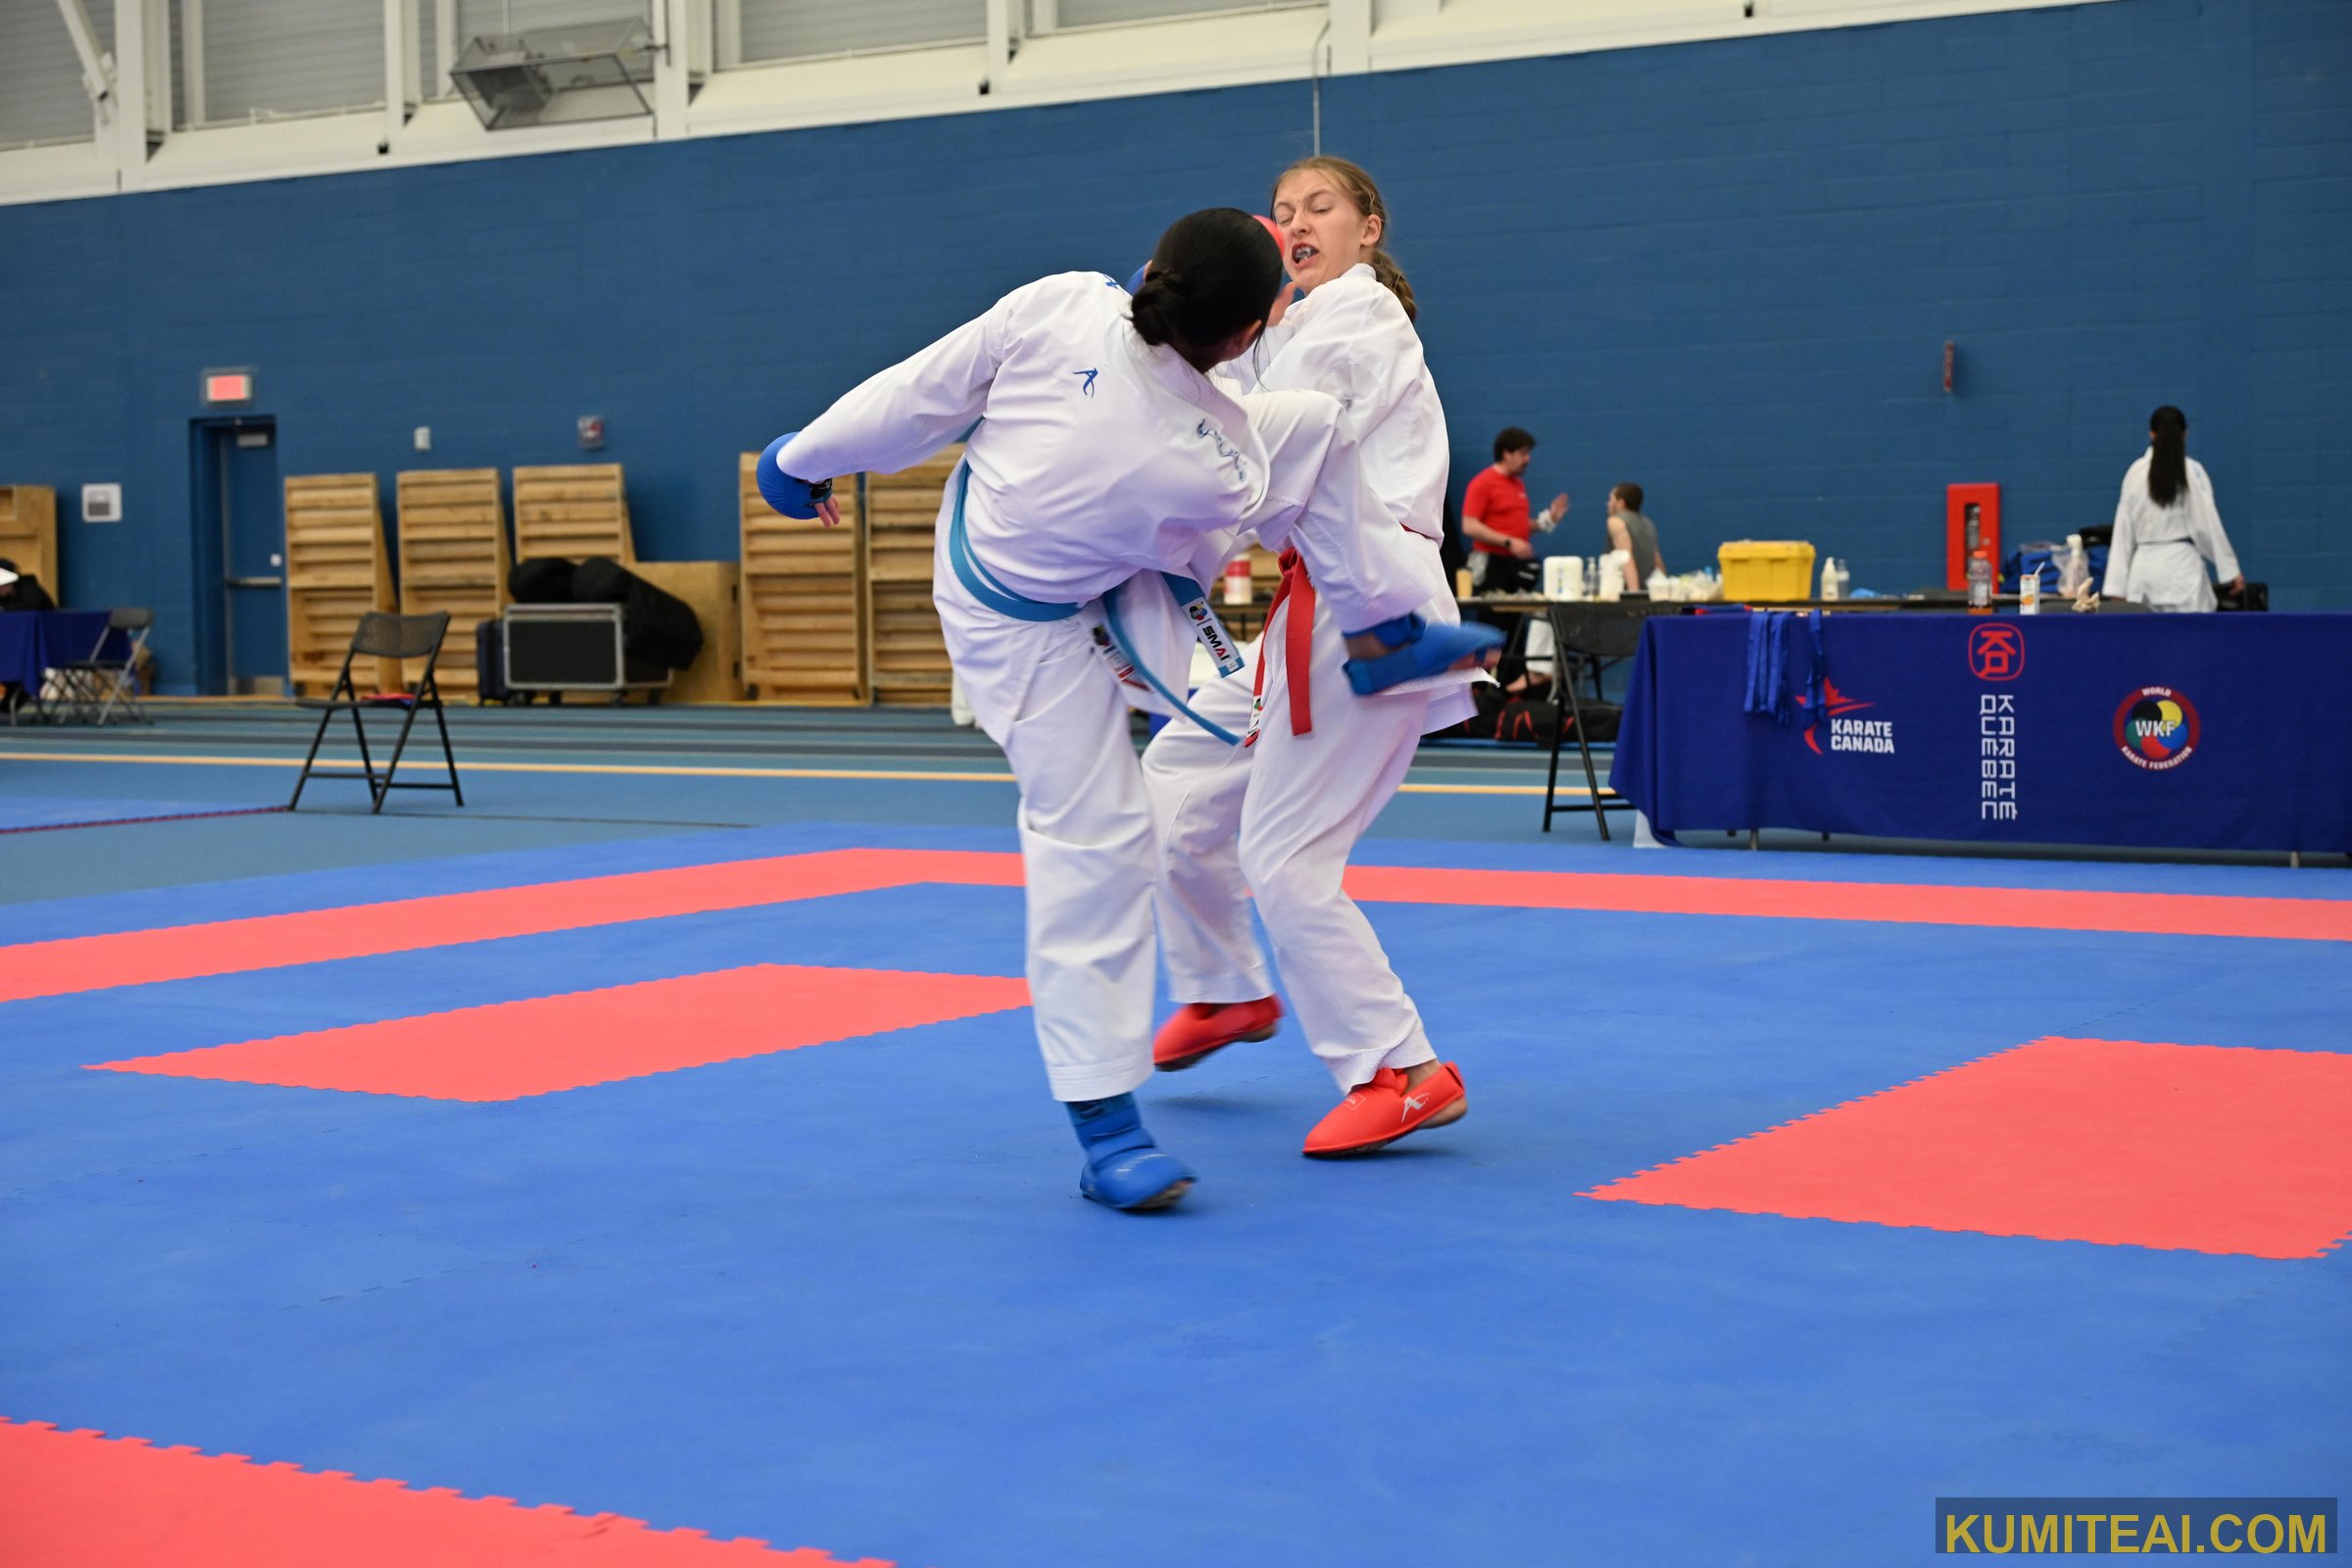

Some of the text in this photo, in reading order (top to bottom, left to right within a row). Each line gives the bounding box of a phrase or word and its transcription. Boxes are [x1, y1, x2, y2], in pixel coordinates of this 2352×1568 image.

[1201, 625, 1232, 662] SMAI
[2140, 687, 2172, 697] WORLD
[1831, 718, 1892, 737] KARATE
[2134, 720, 2176, 738] WKF
[1831, 734, 1895, 754] CANADA
[1980, 694, 1998, 820] QUÉBEC
